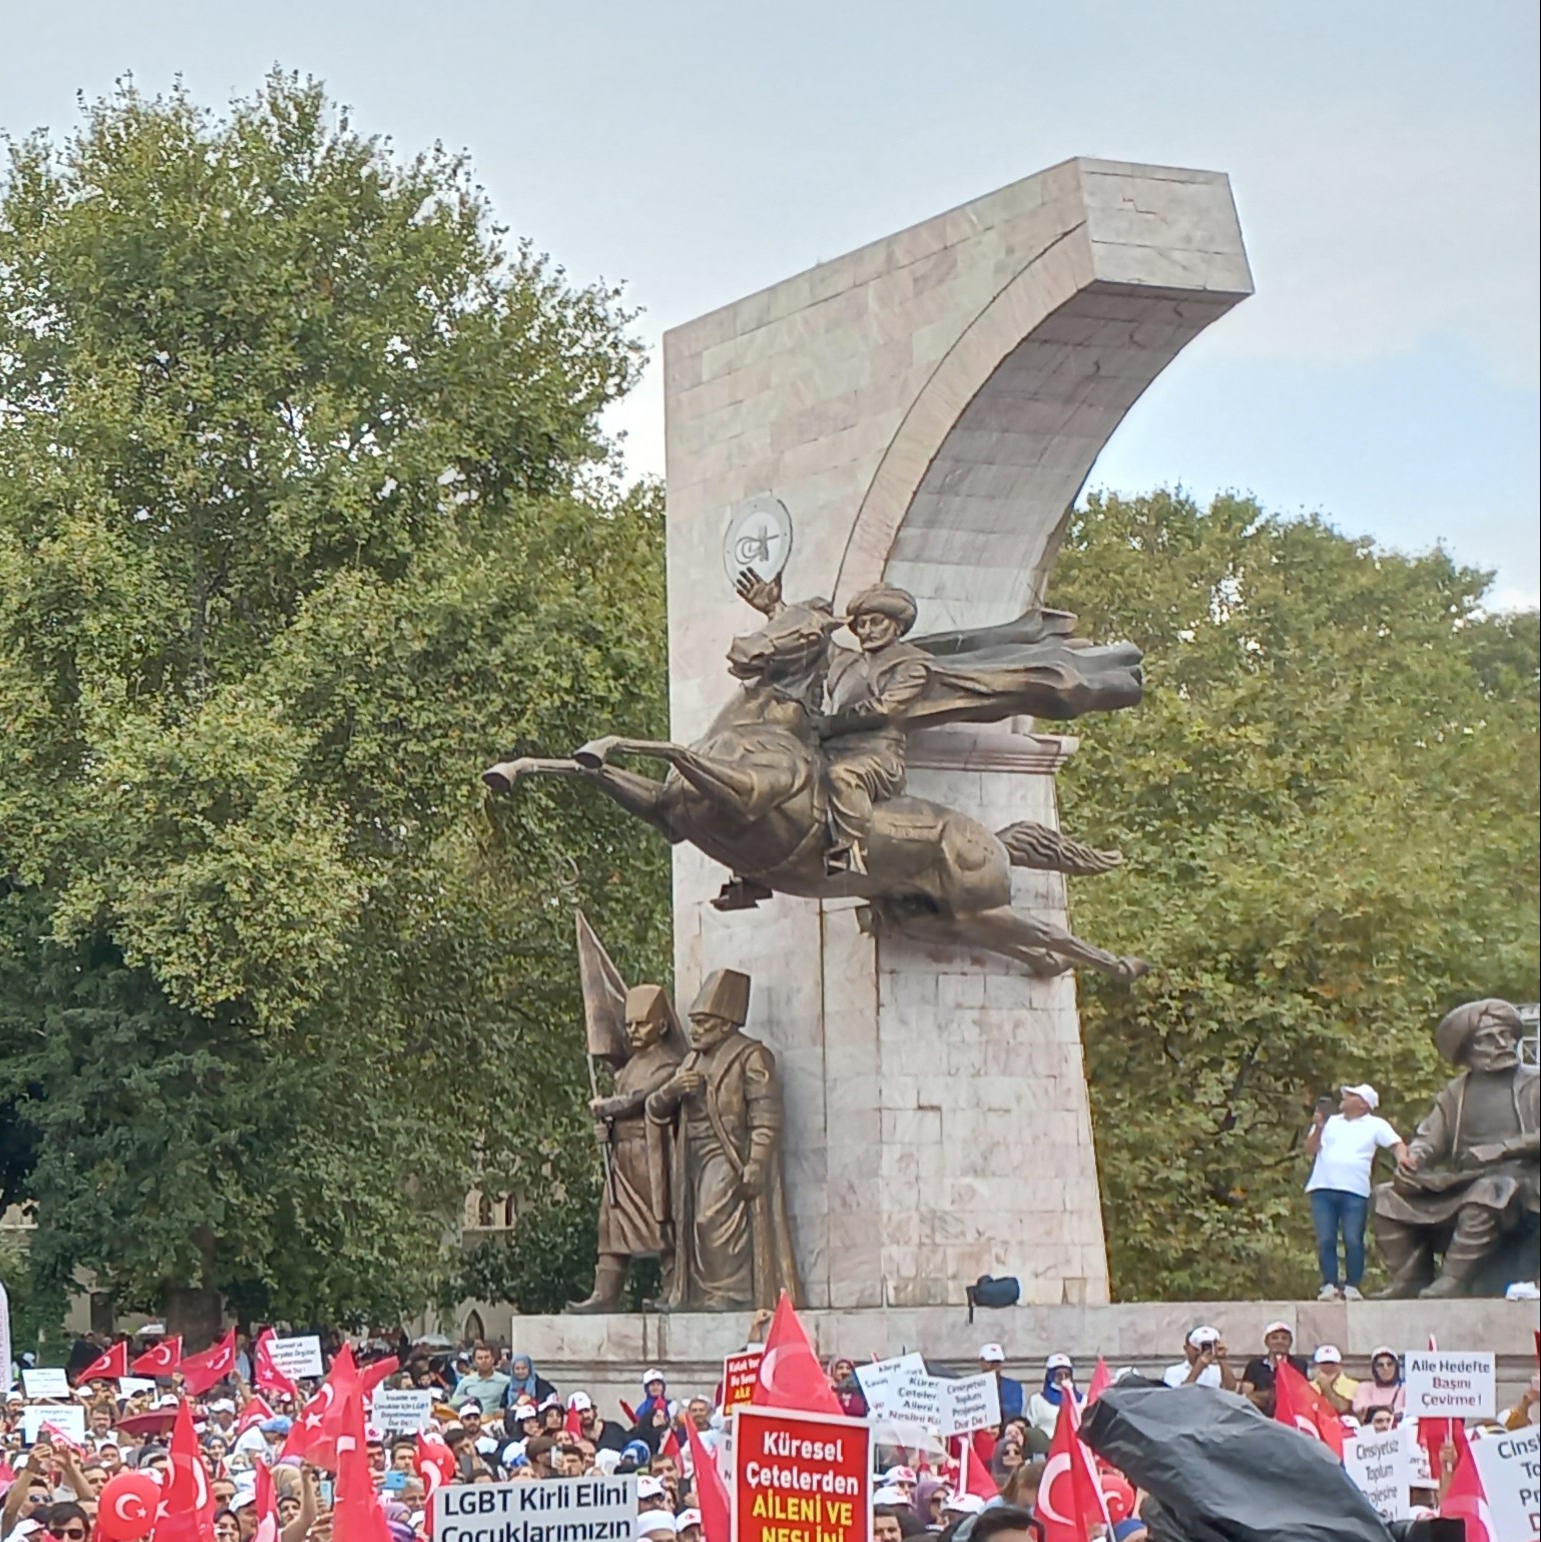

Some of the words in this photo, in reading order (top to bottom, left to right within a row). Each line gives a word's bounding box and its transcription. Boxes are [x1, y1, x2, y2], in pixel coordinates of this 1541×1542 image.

[763, 1431, 844, 1462] Küresel
[746, 1462, 859, 1495] Çetelerden
[444, 1489, 512, 1516] LGBT
[520, 1485, 569, 1511] Kirli
[576, 1481, 628, 1507] Elini
[752, 1490, 821, 1522] AİLENİ
[826, 1501, 852, 1526] VE
